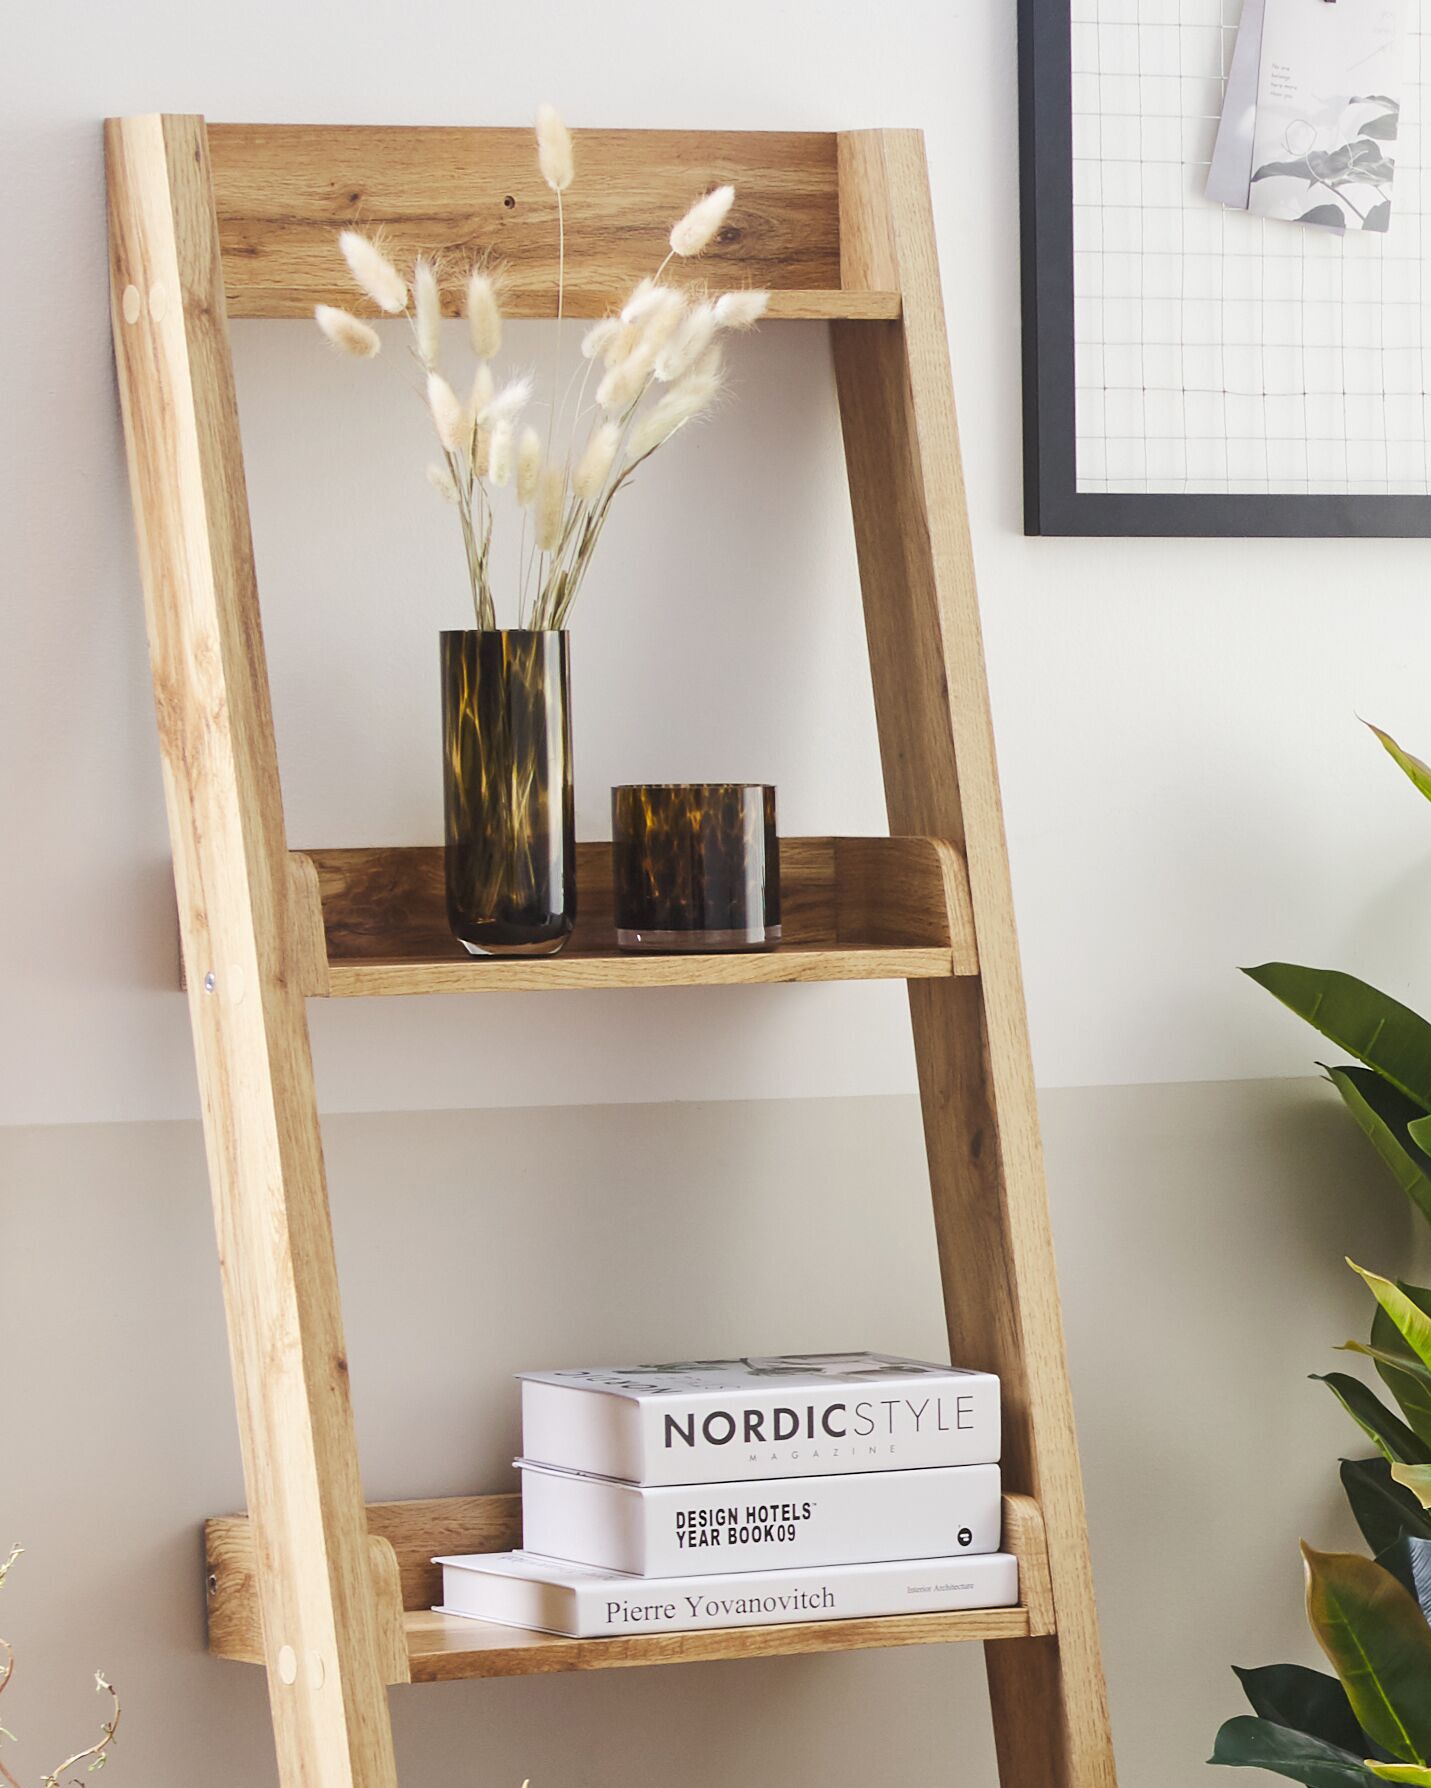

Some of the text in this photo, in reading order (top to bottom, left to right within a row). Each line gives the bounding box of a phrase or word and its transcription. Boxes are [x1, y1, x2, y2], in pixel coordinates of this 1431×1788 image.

[749, 1445, 896, 1462] MAGAZINE
[676, 1507, 738, 1529] DESIGN
[676, 1529, 720, 1549] YEAR
[605, 1586, 836, 1623] Pierre Yovanovitch
